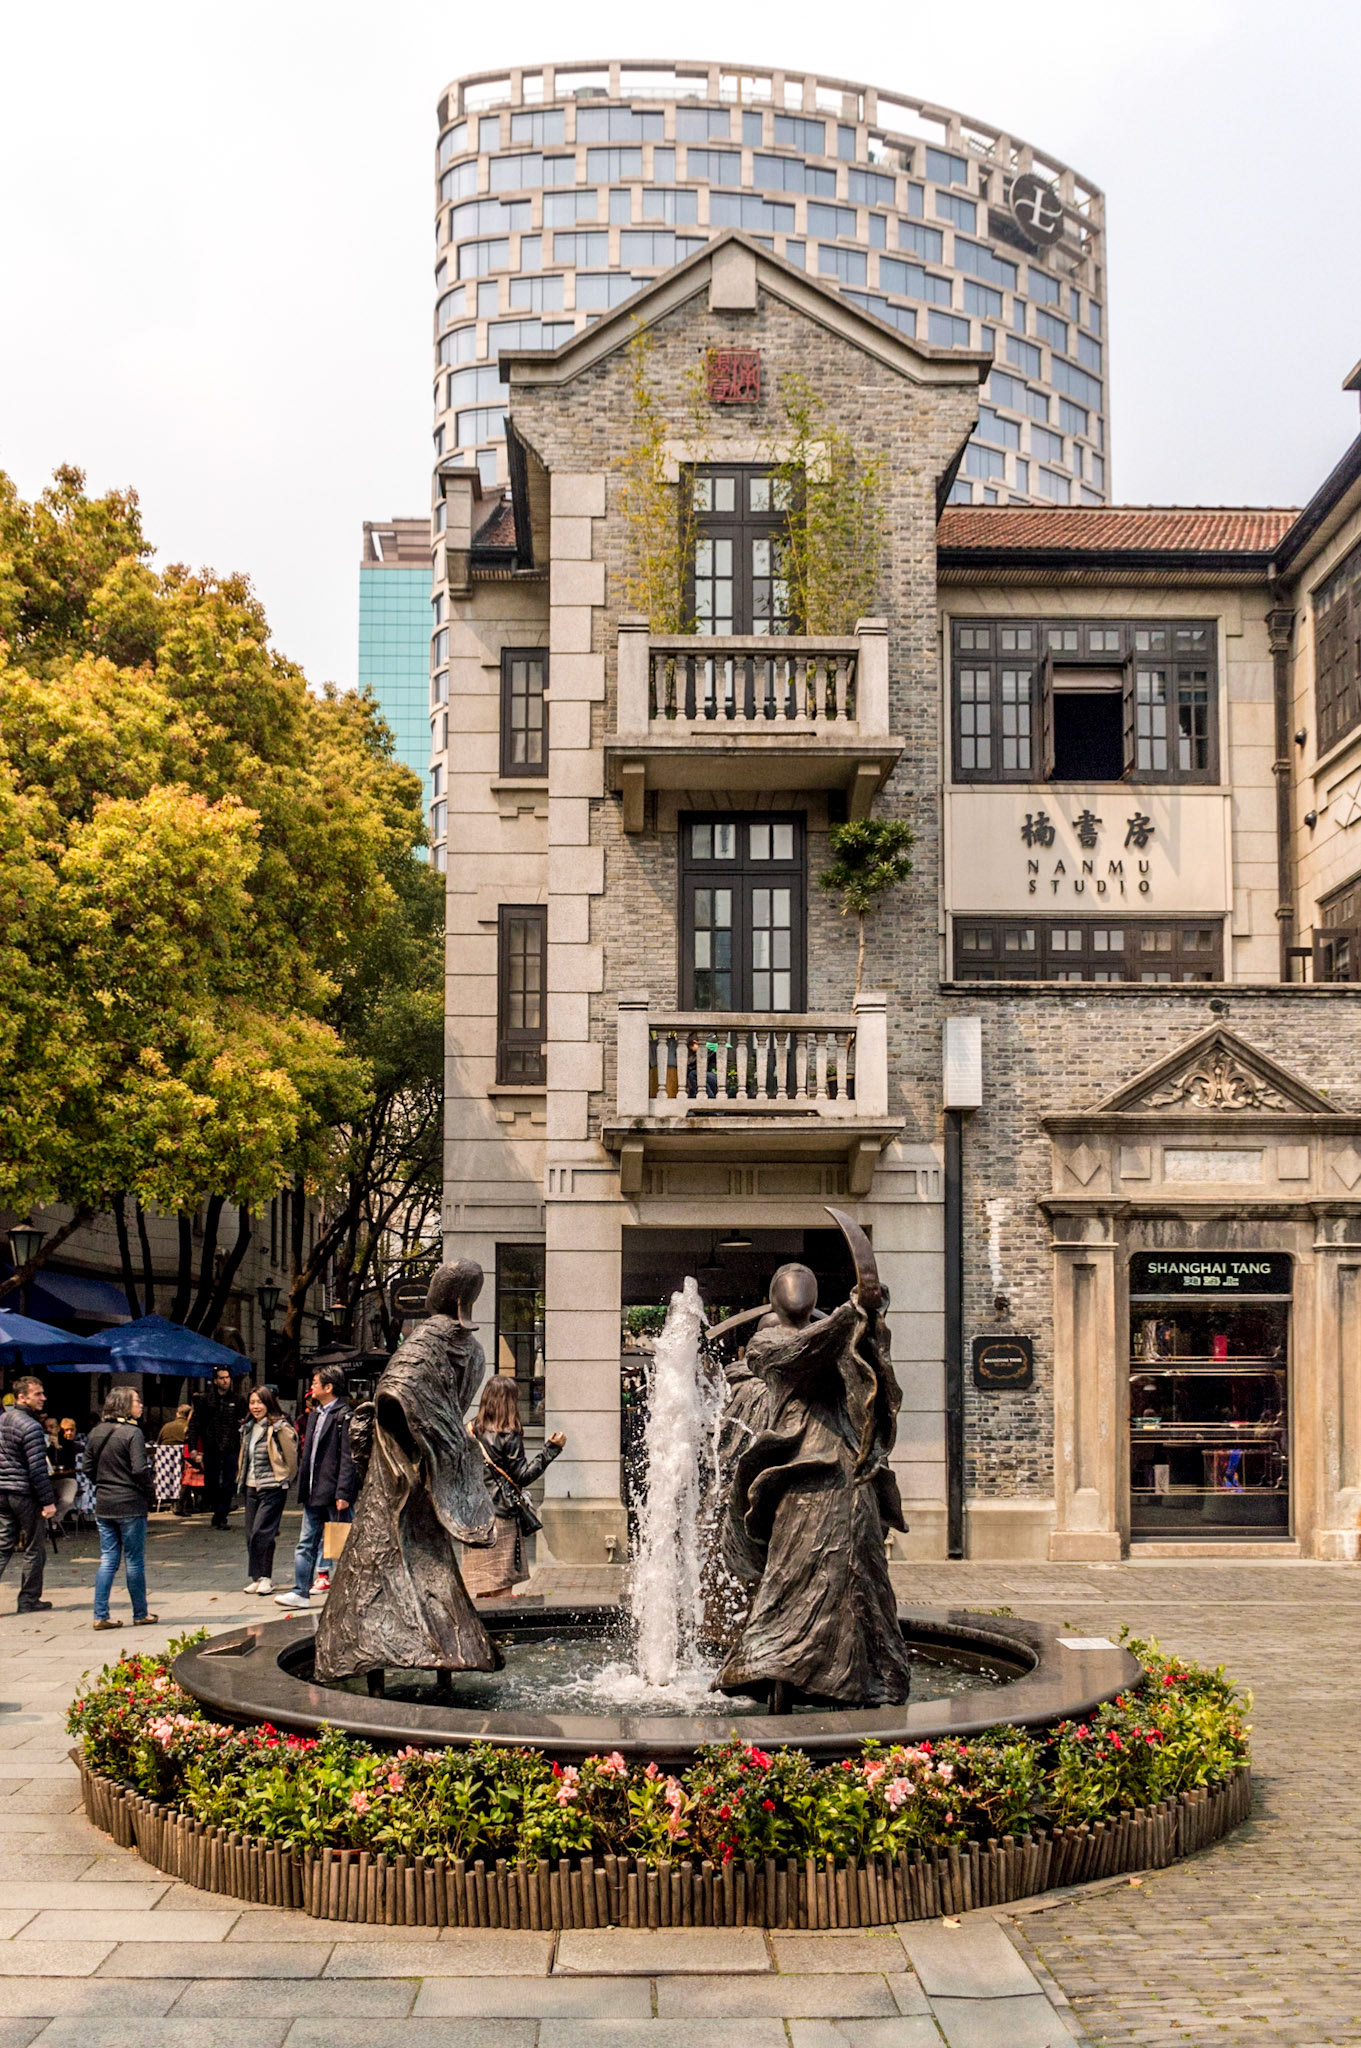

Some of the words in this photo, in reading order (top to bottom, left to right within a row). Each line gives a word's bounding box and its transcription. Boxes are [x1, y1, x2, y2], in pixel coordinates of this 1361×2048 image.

[1021, 810, 1155, 848] 楠書房
[1028, 860, 1149, 875] NANMU
[1029, 880, 1149, 894] STUDIO
[1148, 1262, 1226, 1274] SHANGHAI
[1230, 1262, 1271, 1274] TANG
